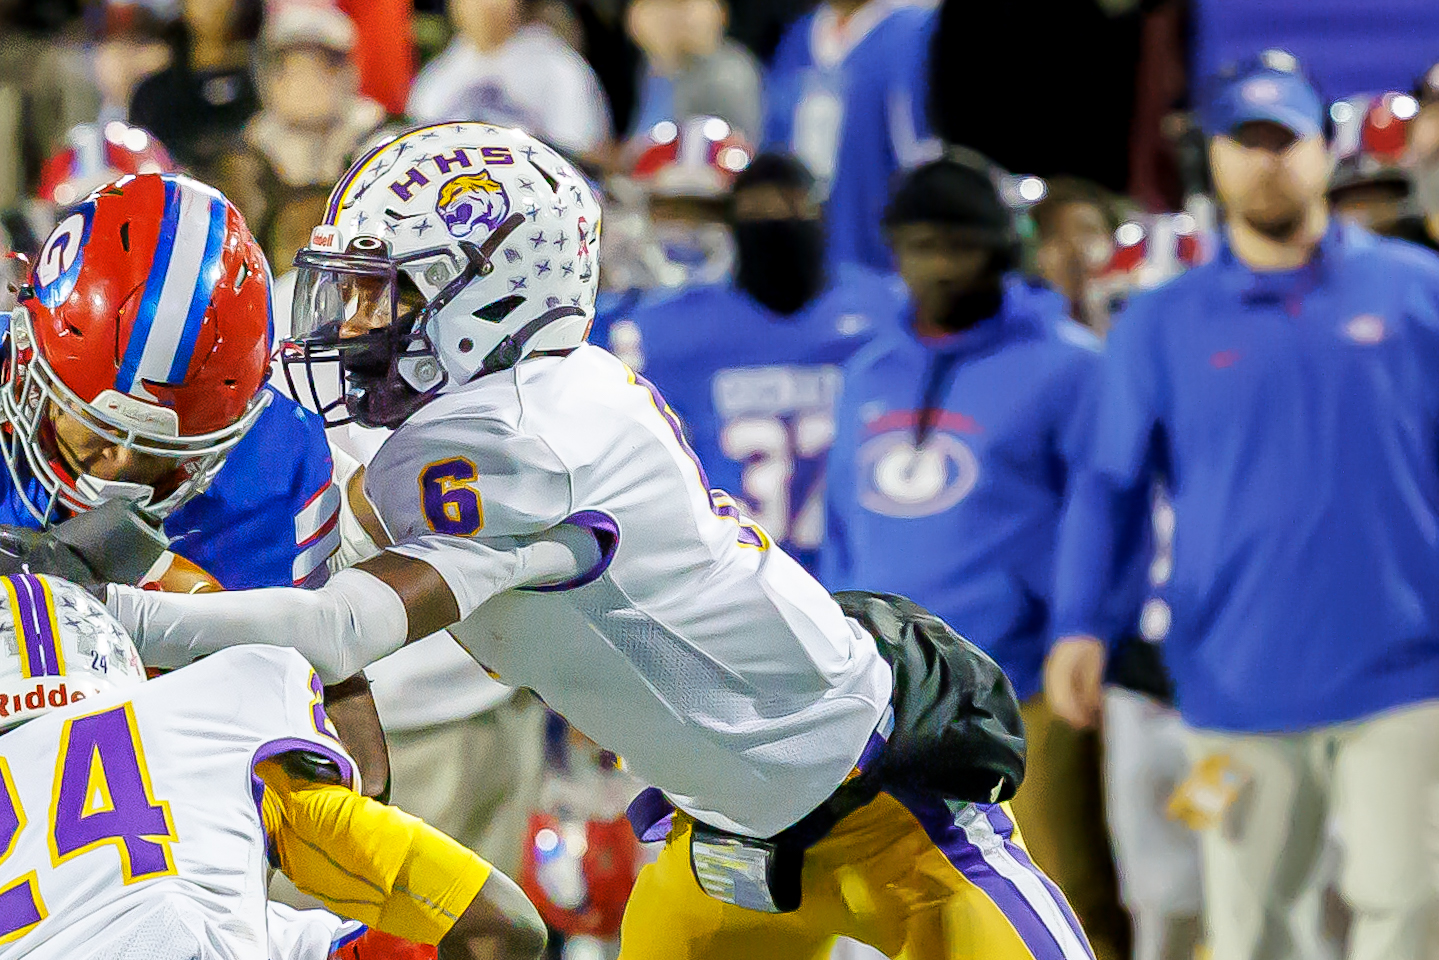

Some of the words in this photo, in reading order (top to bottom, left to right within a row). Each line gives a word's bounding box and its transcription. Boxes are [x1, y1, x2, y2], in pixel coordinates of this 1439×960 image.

[388, 147, 516, 202] HHS
[419, 455, 483, 537] 6
[90, 650, 108, 674] 24
